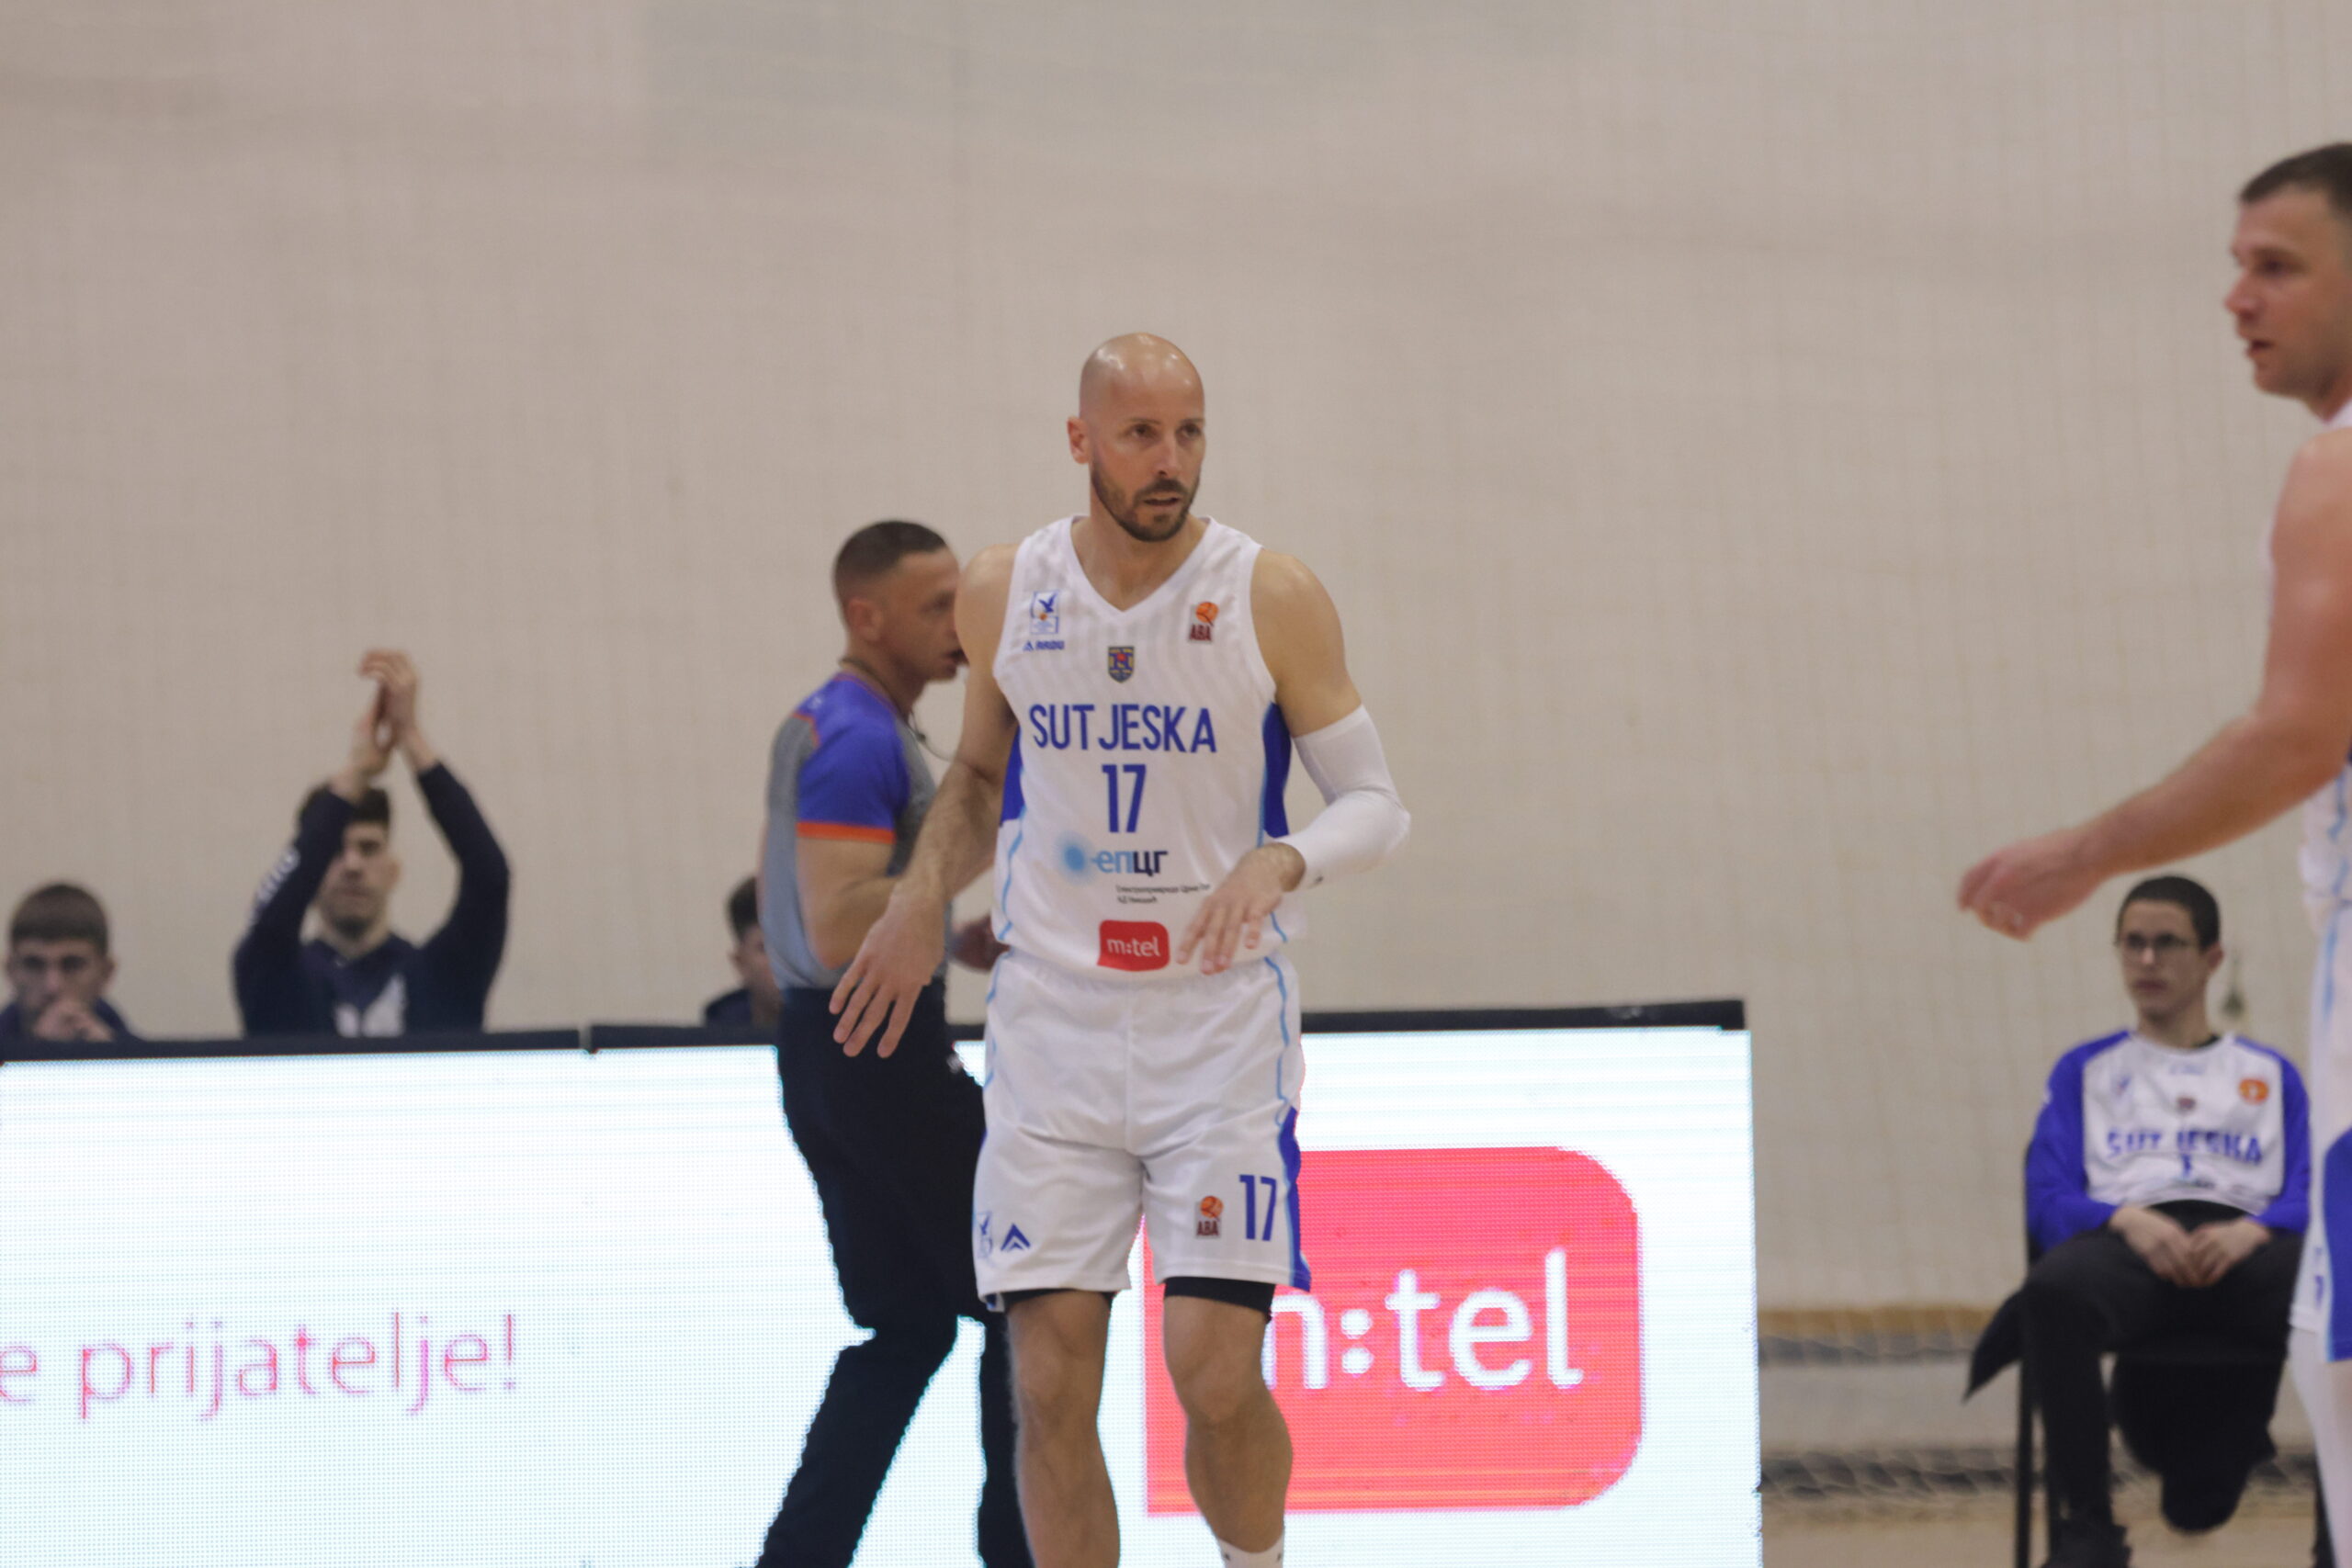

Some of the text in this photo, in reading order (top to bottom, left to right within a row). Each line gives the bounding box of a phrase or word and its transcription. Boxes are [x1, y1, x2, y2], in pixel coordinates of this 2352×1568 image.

[1190, 624, 1212, 641] ABA
[1101, 763, 1147, 833] 17
[1096, 850, 1169, 877] епцг
[1106, 936, 1161, 957] m:tel
[1238, 1173, 1277, 1242] 17
[1196, 1220, 1219, 1237] ABA
[80, 1309, 517, 1422] prijatelje!
